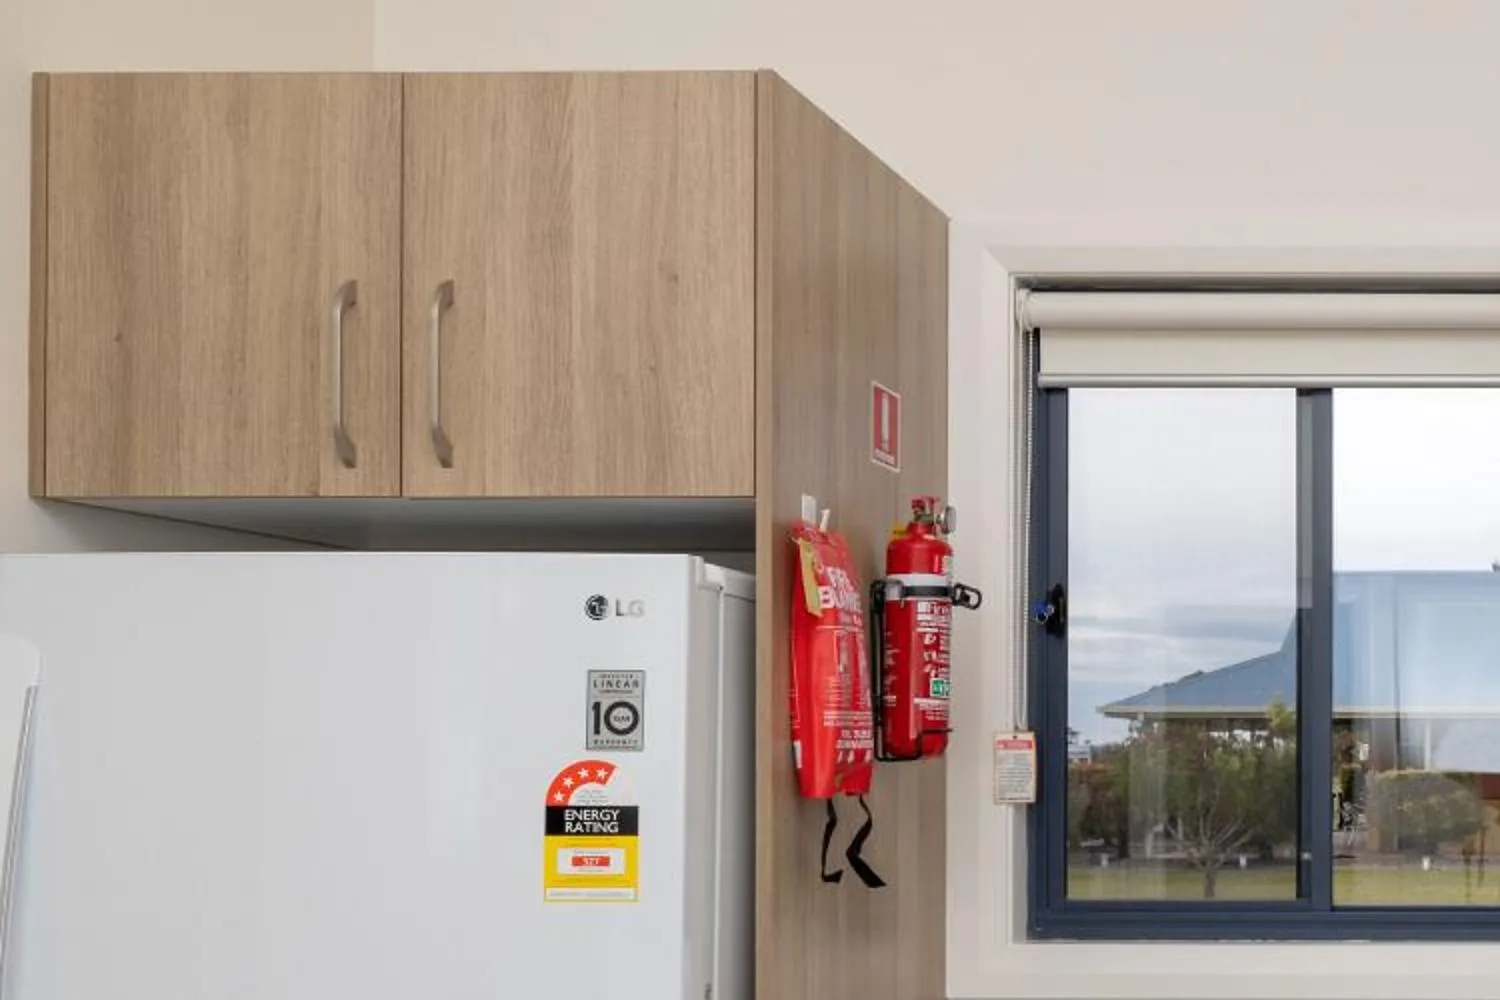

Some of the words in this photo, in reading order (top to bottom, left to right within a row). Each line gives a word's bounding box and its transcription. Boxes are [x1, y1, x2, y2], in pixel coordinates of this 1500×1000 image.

[615, 599, 645, 618] LG
[593, 680, 639, 688] LINEAR
[592, 701, 639, 736] 10
[565, 809, 620, 821] ENERGY
[565, 821, 619, 833] RATING
